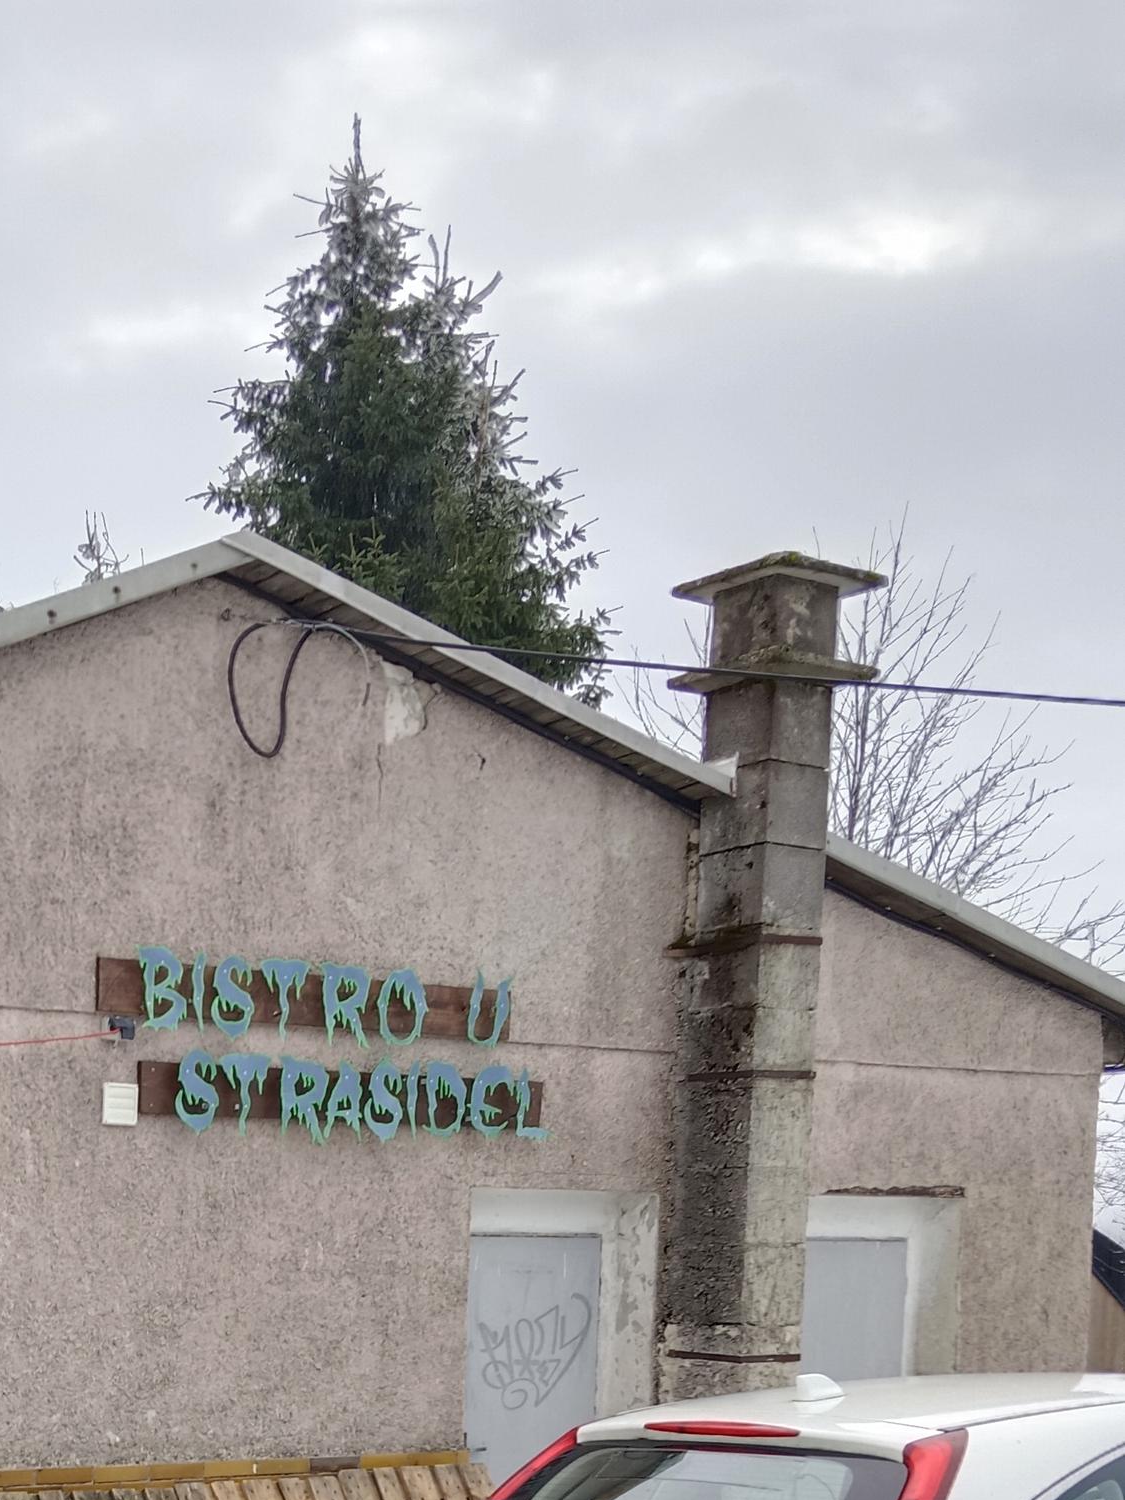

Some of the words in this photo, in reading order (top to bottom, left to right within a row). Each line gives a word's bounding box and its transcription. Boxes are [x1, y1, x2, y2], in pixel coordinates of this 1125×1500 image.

[137, 944, 431, 1048] BISTRO
[467, 967, 514, 1049] U
[175, 1048, 555, 1146] STRASIDEL
